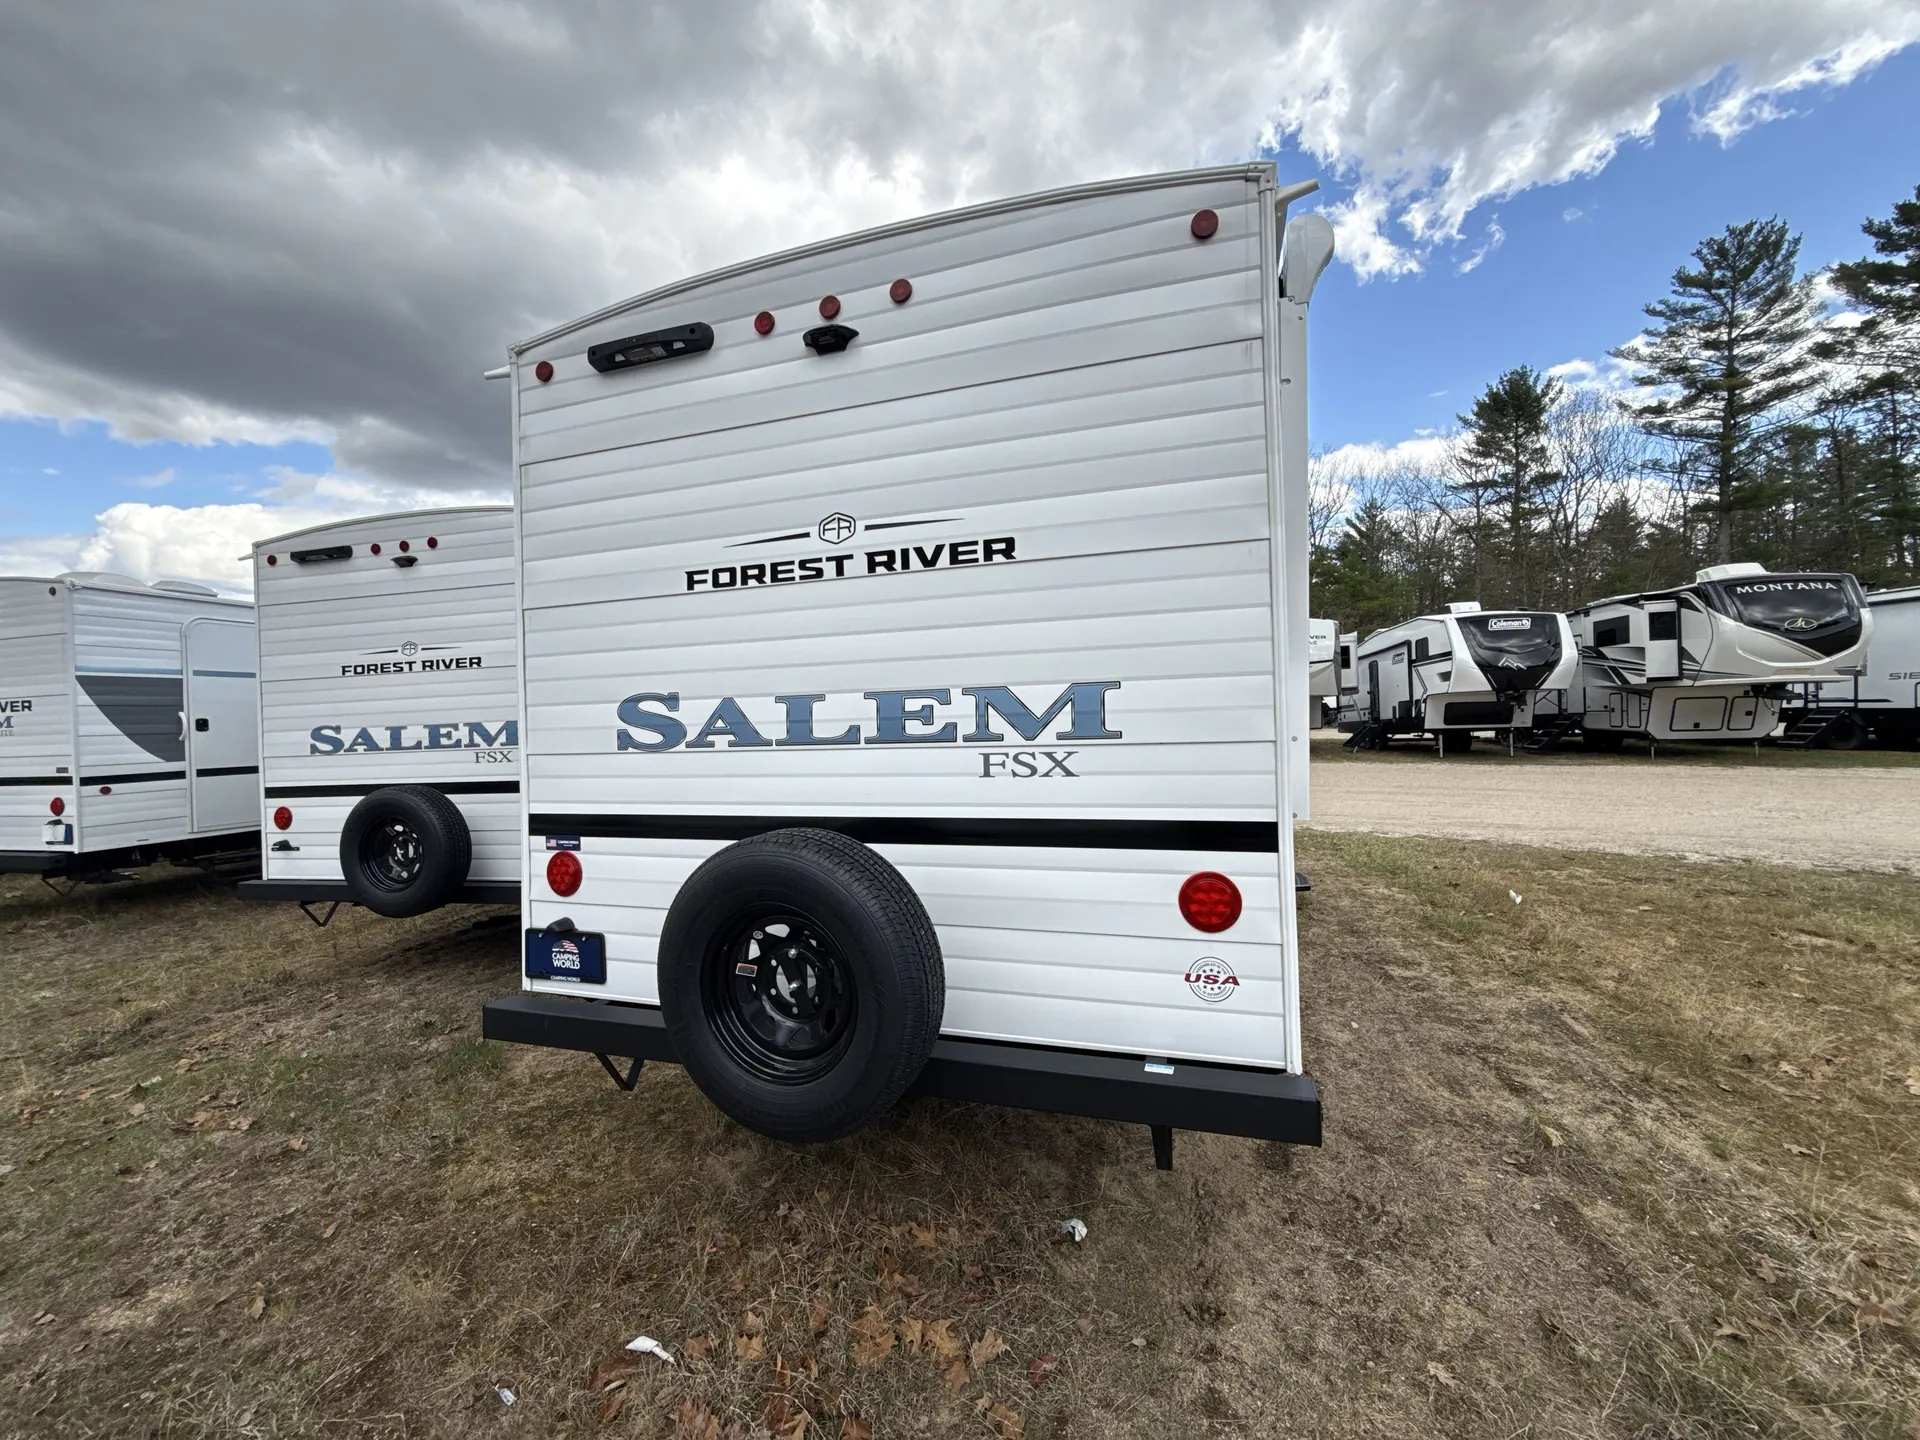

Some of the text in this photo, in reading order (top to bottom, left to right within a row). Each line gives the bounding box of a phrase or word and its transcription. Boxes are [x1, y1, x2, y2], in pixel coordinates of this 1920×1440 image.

[684, 536, 1017, 592] FOREST RIVER
[1736, 582, 1838, 594] MONTANA
[1491, 620, 1522, 628] Coleman
[341, 656, 482, 676] FOREST RIVER
[616, 681, 1123, 752] SALEM
[310, 720, 519, 755] SALEM
[474, 750, 514, 764] FSX
[978, 750, 1080, 778] FSX
[551, 952, 580, 962] CAMPING
[552, 959, 581, 970] WORLD
[1184, 973, 1240, 986] USA
